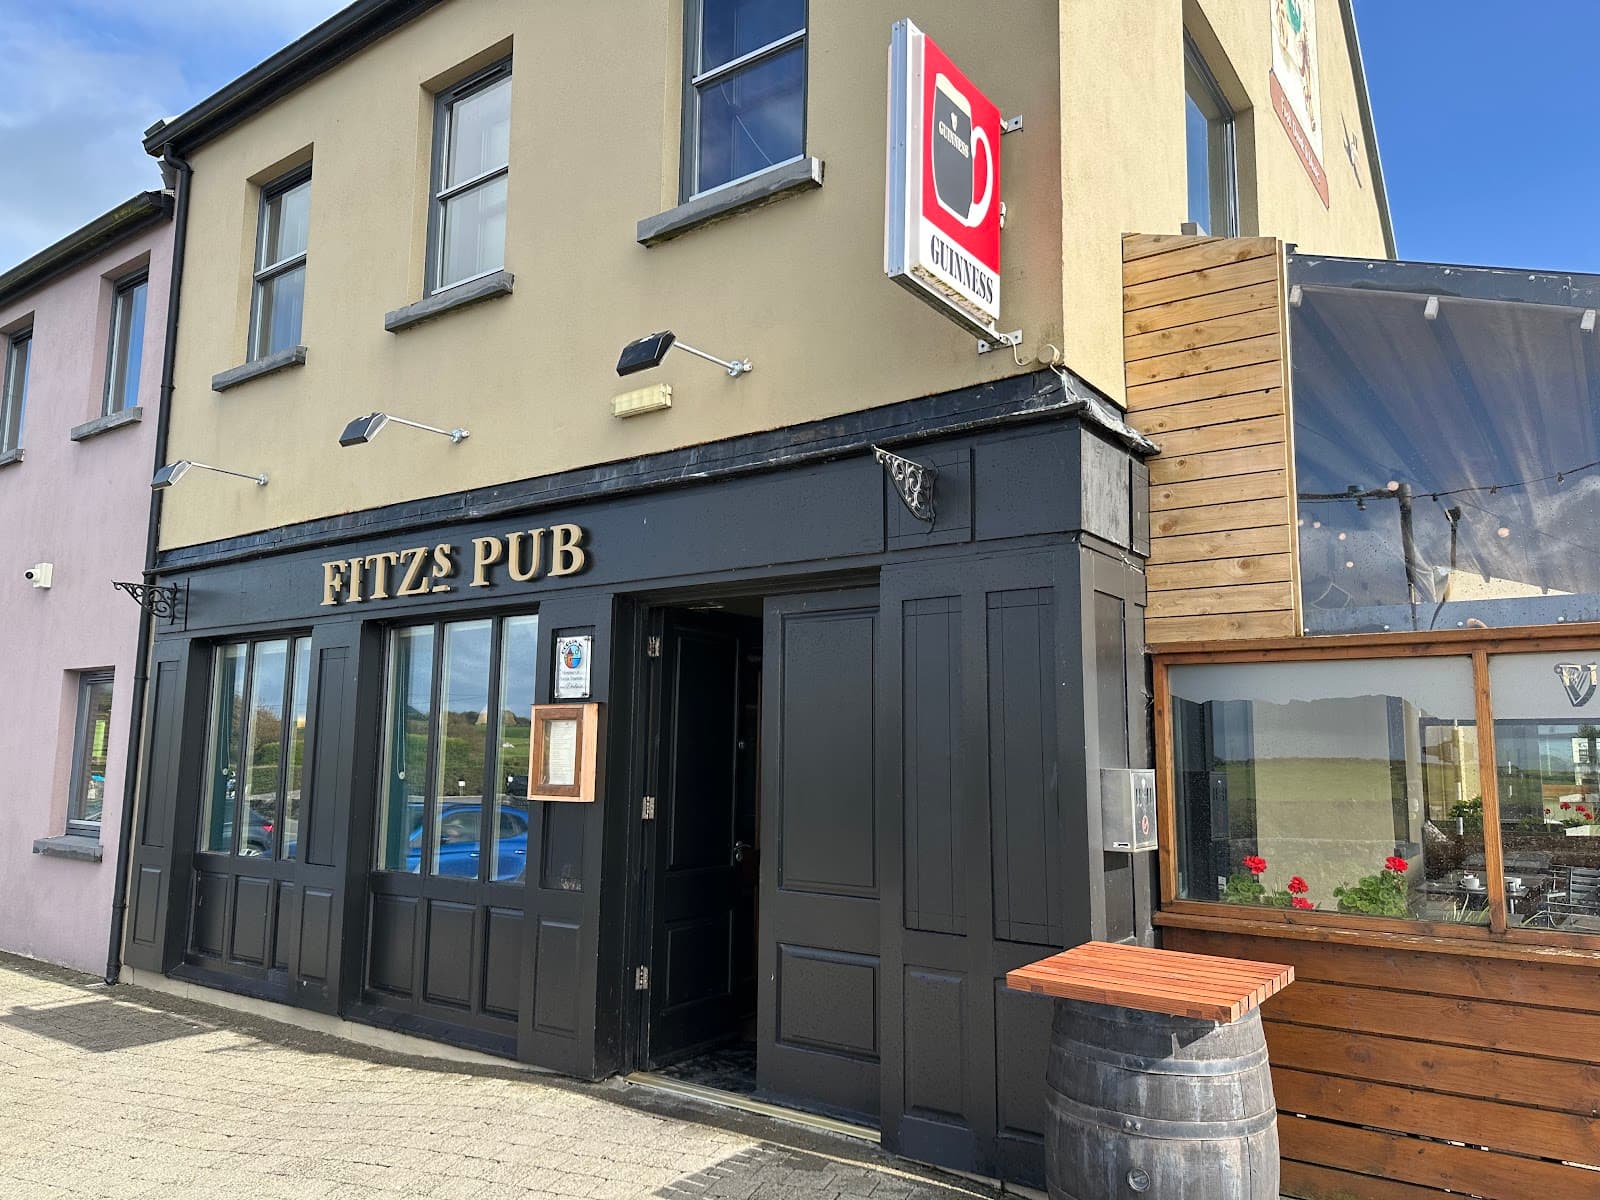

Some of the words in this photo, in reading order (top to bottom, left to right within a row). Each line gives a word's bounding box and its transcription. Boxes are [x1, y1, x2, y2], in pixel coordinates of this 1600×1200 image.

[938, 120, 969, 158] GUINNESS
[930, 234, 993, 305] GUINNESS
[469, 523, 585, 587] PUB
